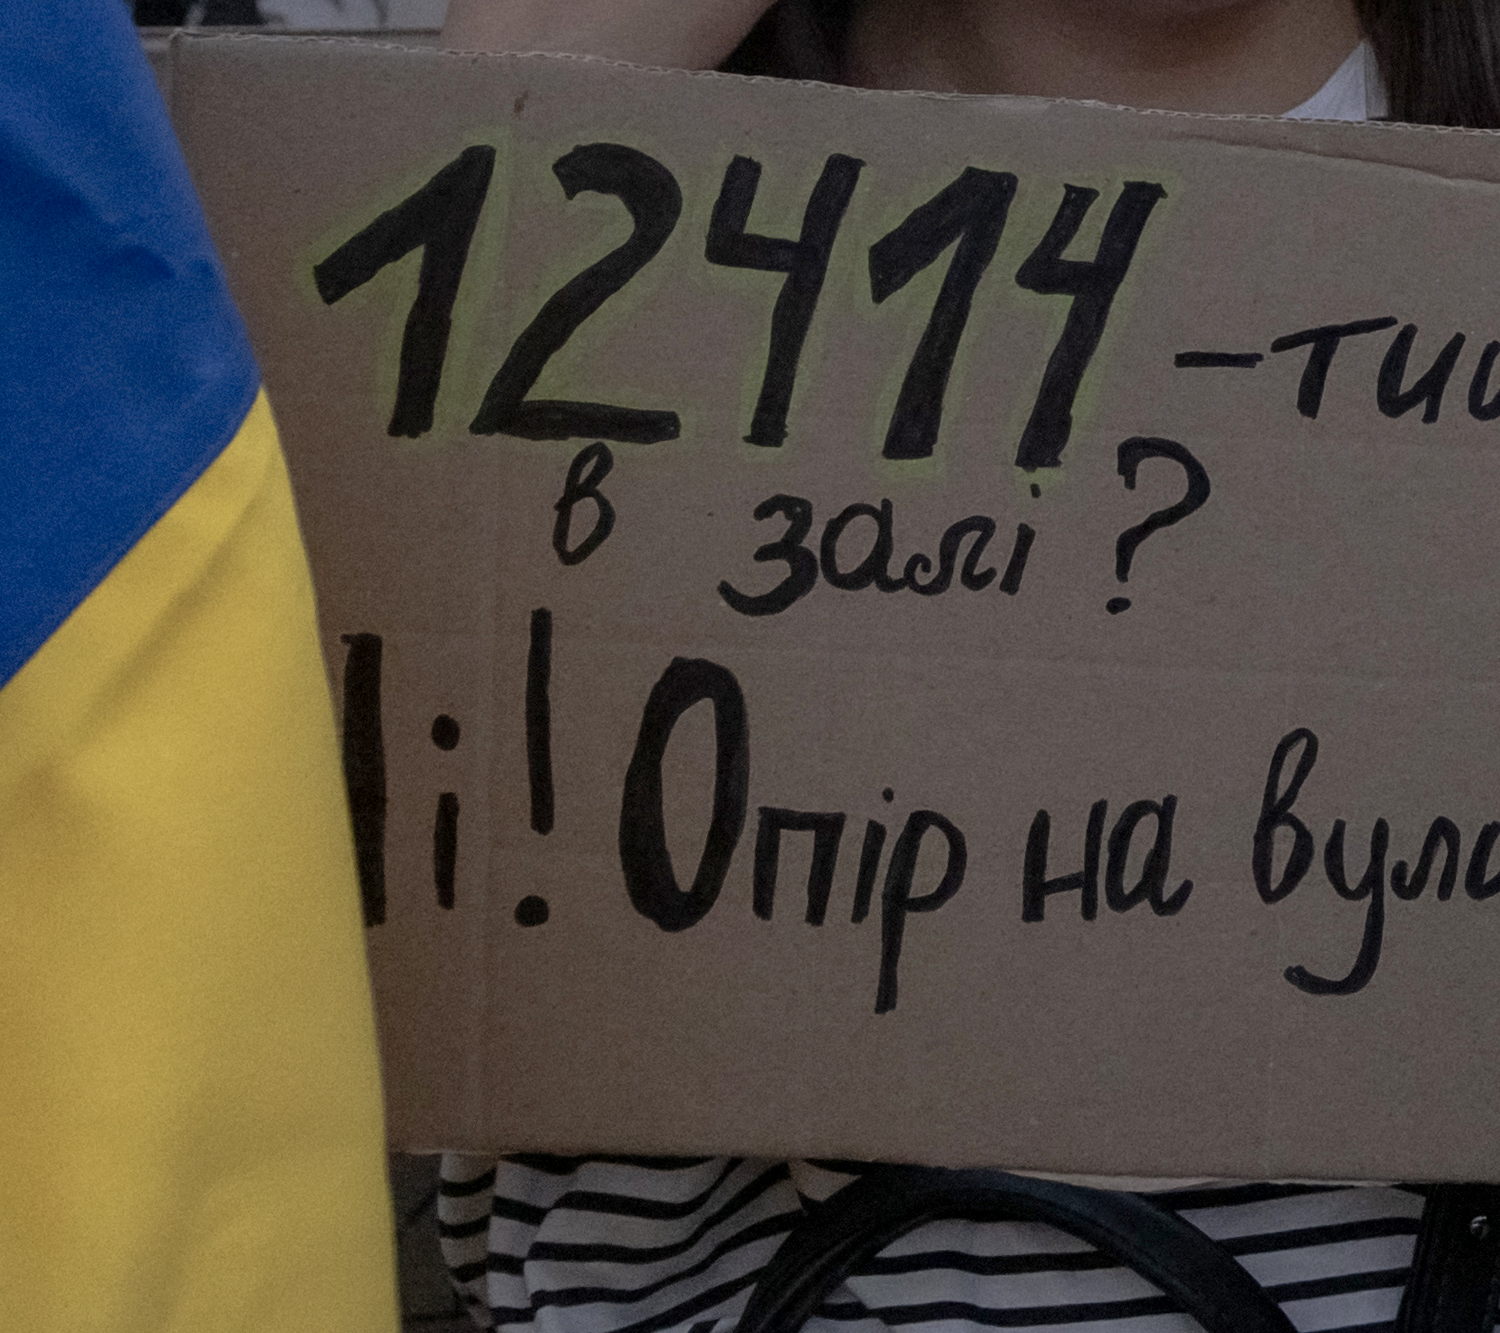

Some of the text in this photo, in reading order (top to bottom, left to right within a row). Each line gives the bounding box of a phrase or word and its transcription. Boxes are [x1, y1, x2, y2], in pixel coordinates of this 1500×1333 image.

[313, 144, 1168, 470] 12414
[619, 657, 967, 1014] Опір
[1022, 795, 1192, 923] на
